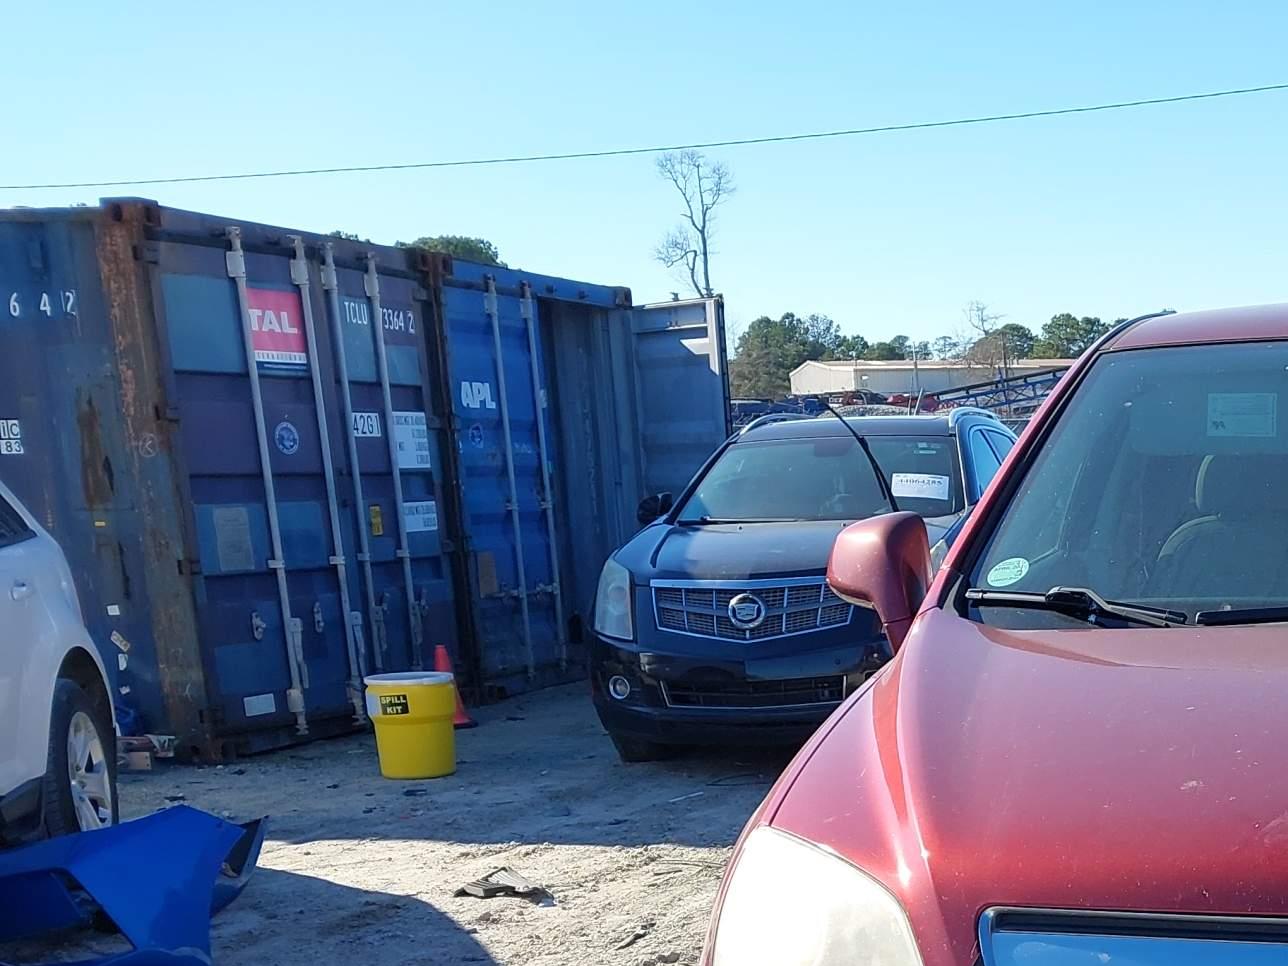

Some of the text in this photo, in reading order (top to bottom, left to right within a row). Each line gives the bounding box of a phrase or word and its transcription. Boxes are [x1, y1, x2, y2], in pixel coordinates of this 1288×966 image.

[248, 308, 298, 334] TAL
[343, 301, 368, 325] TCLU
[379, 307, 404, 332] 3364
[461, 381, 497, 409] APL
[353, 414, 380, 435] 42G1
[5, 441, 21, 452] 83
[381, 696, 406, 704] SPILL
[386, 706, 402, 714] KIT
